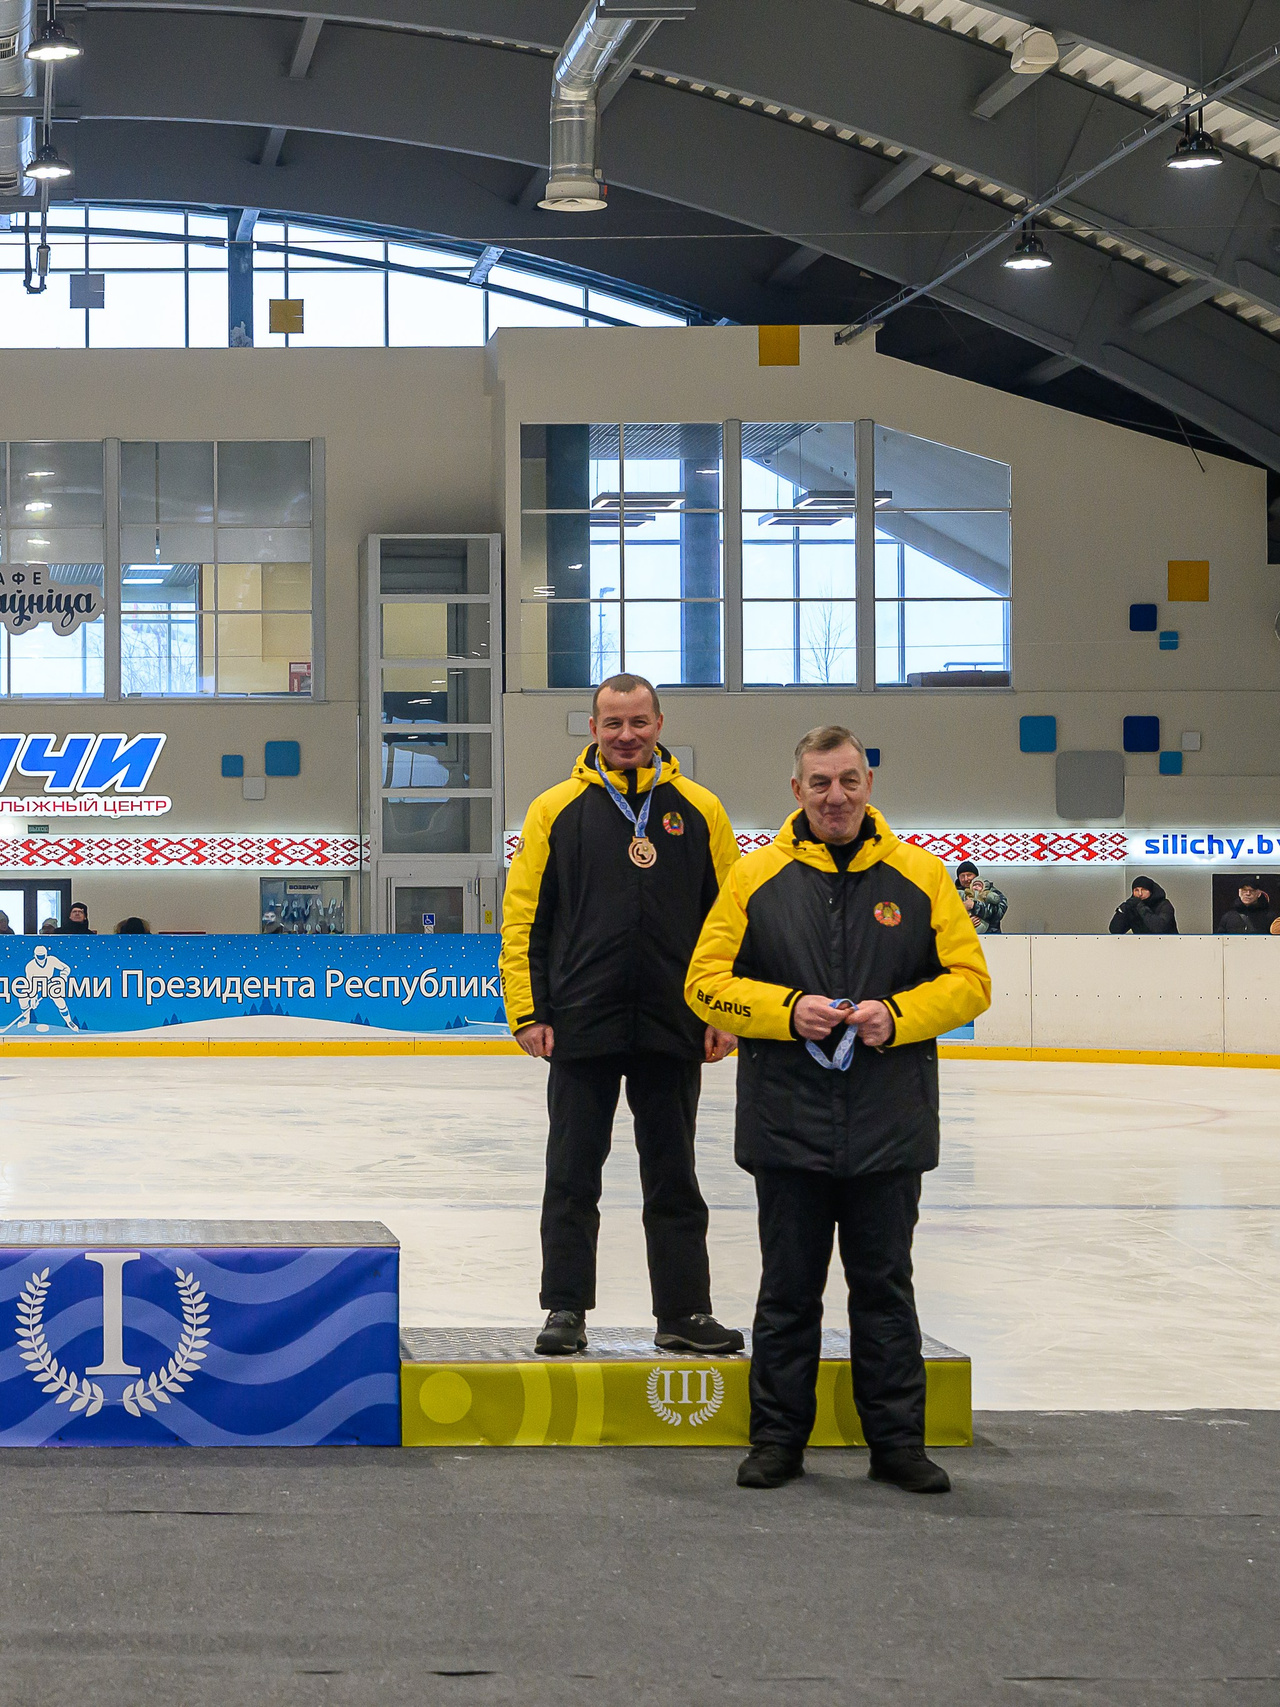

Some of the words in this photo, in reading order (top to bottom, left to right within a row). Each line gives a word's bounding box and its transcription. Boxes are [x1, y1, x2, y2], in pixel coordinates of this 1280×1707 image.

[103, 800, 168, 815] ЦЕНТР
[1144, 834, 1280, 859] silichy.b
[121, 969, 315, 1005] Президента
[324, 967, 504, 1006] Республик
[84, 1252, 141, 1376] I
[660, 1370, 712, 1404] III
